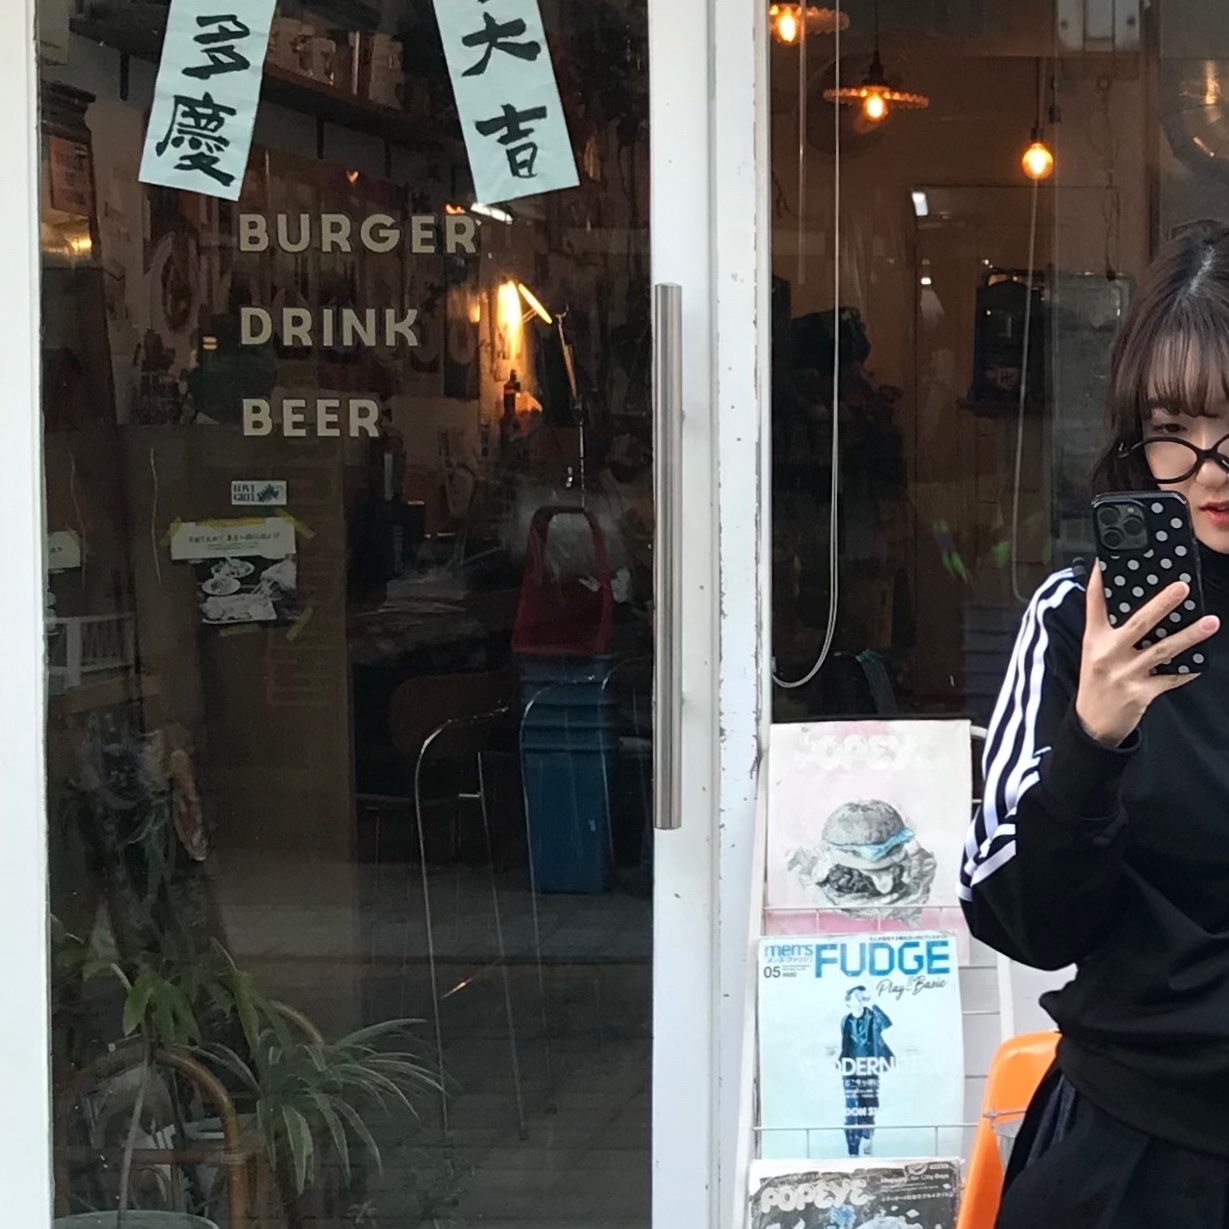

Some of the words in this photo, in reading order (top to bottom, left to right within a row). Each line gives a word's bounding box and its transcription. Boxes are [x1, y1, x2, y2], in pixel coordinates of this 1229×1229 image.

[461, 0, 547, 178] 大吉
[239, 213, 478, 254] BURGER
[240, 307, 420, 347] DRINK
[243, 399, 383, 437] BEER
[763, 966, 781, 979] 05
[815, 940, 950, 978] FUDGE
[760, 1179, 869, 1213] POPEYE
